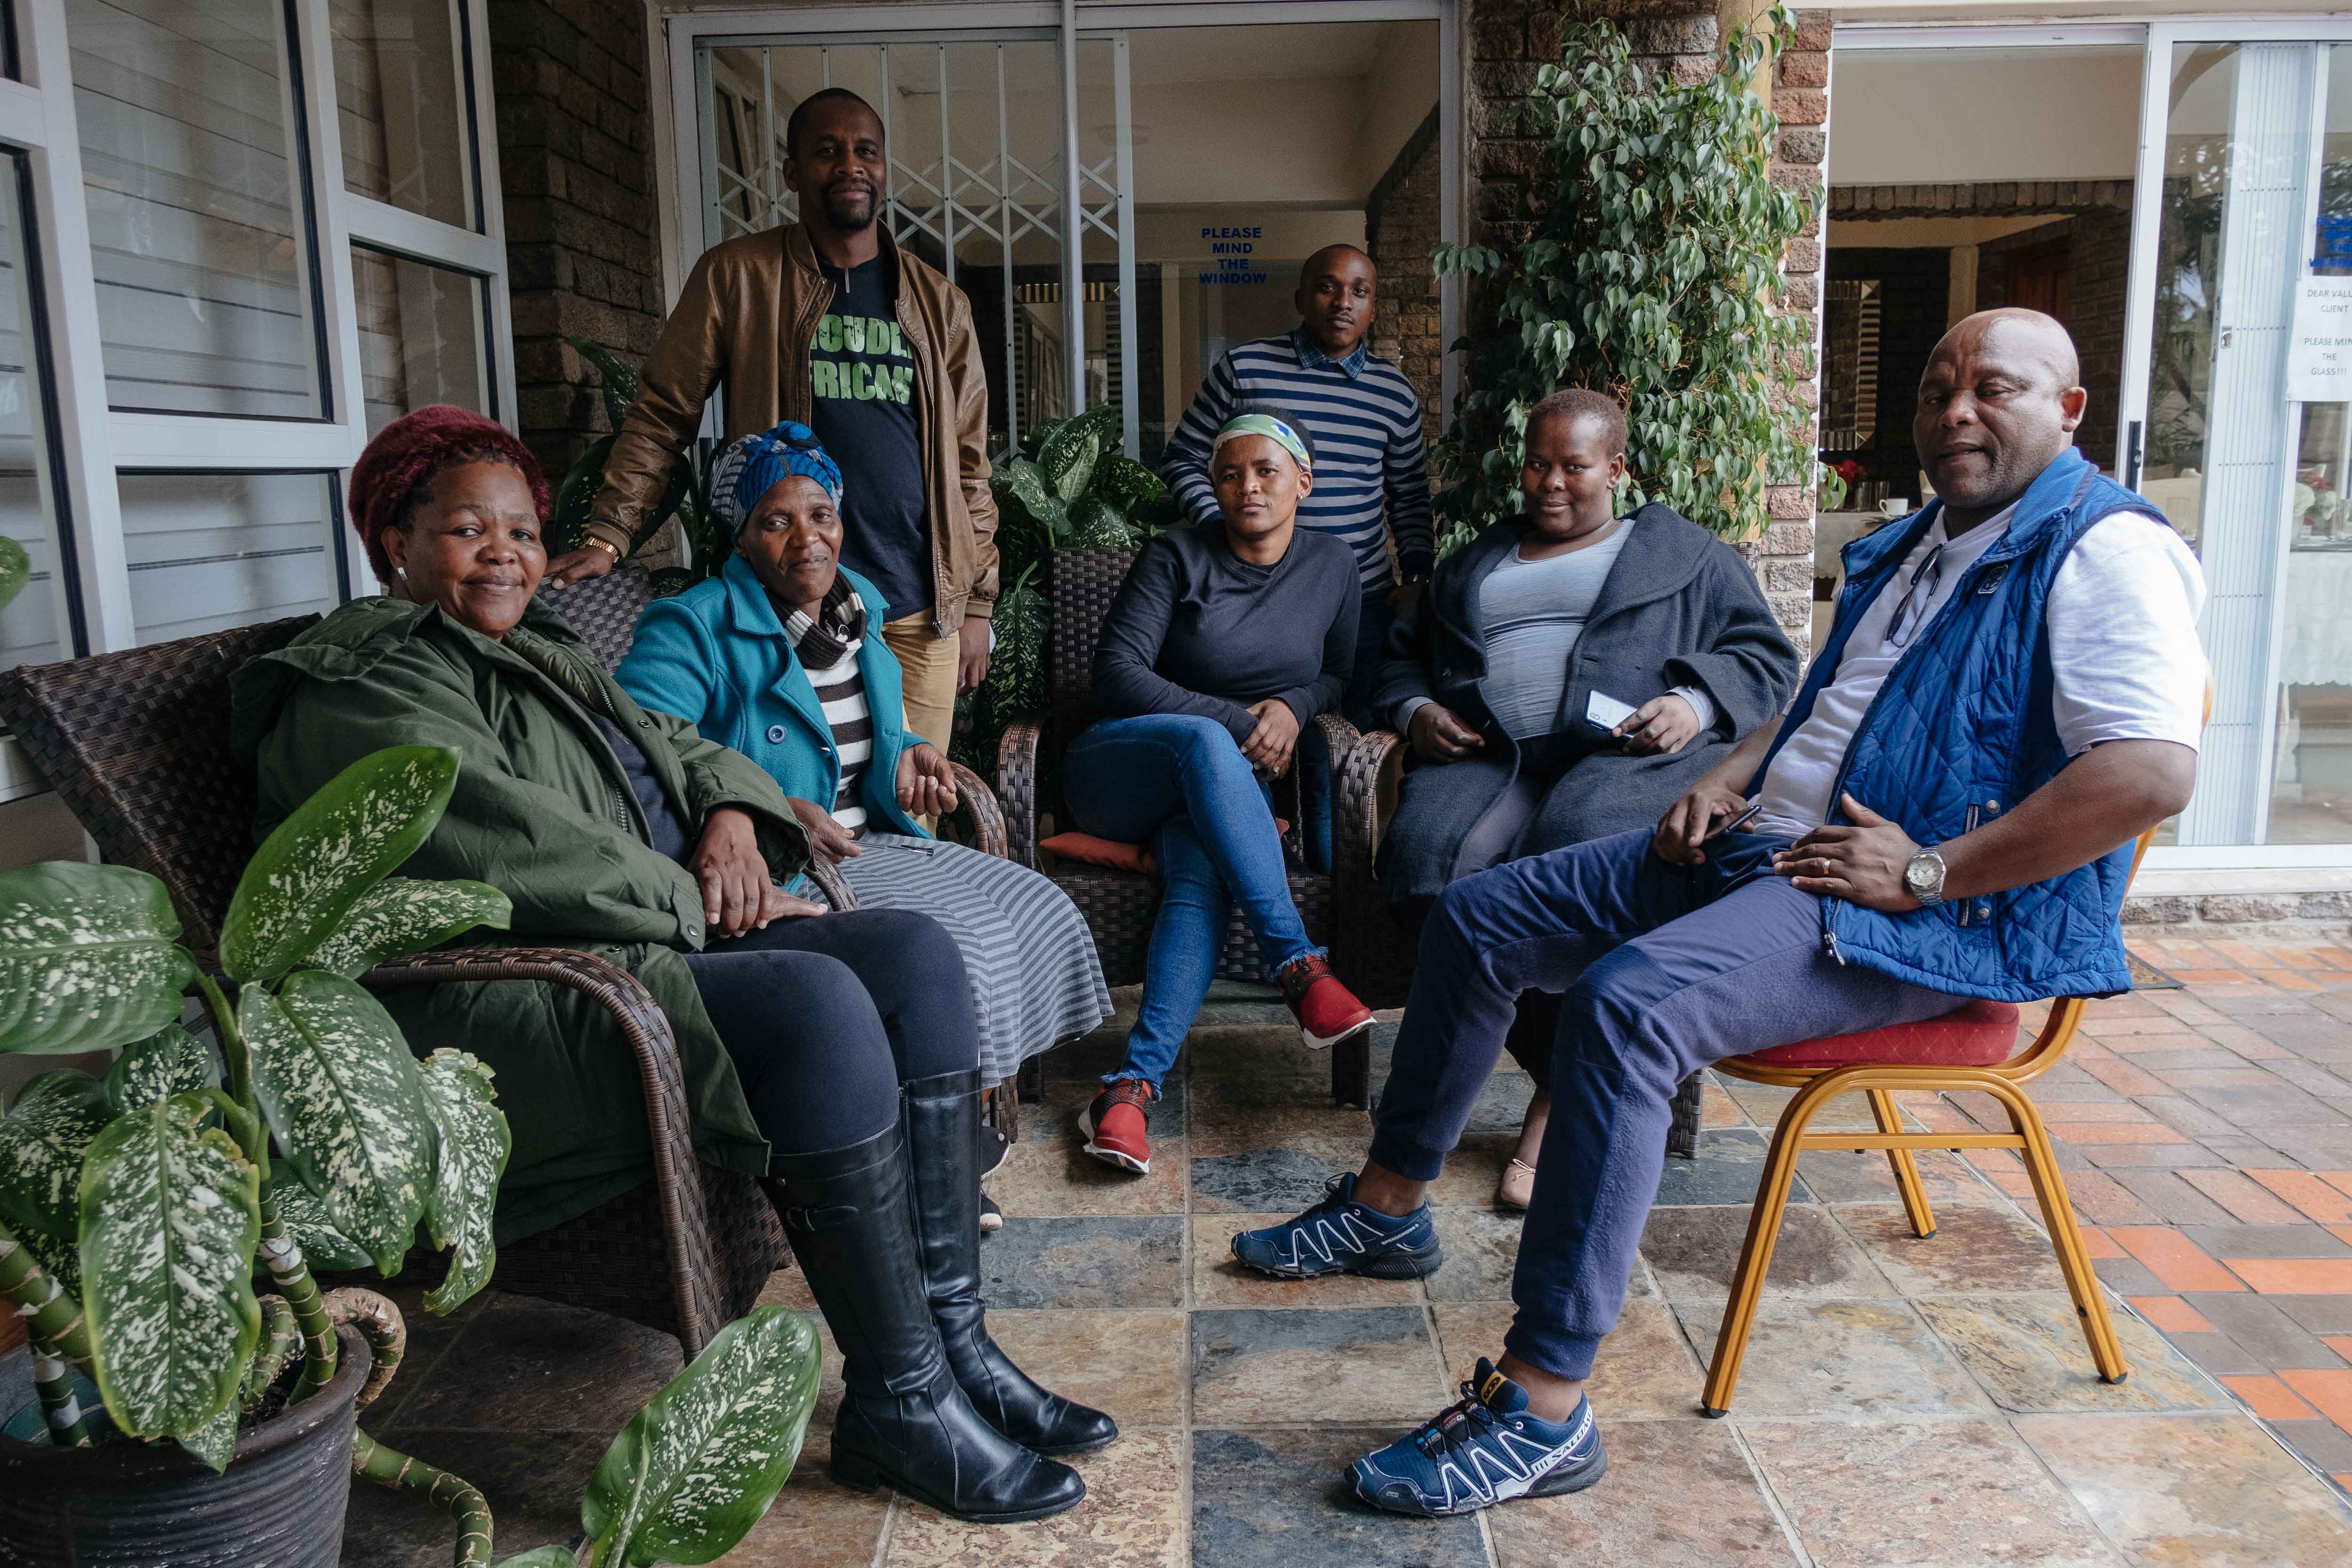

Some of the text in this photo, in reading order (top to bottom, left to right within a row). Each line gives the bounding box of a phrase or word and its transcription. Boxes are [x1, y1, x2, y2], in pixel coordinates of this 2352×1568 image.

[1201, 227, 1262, 239] PLEASE
[1212, 243, 1253, 253] MIND
[1217, 259, 1249, 270] THE
[1199, 273, 1266, 284] WINDOW
[2321, 304, 2349, 313] CLIENT
[810, 314, 914, 359] OUDL
[2304, 337, 2333, 346] PLEASE
[810, 360, 914, 405] RICAN
